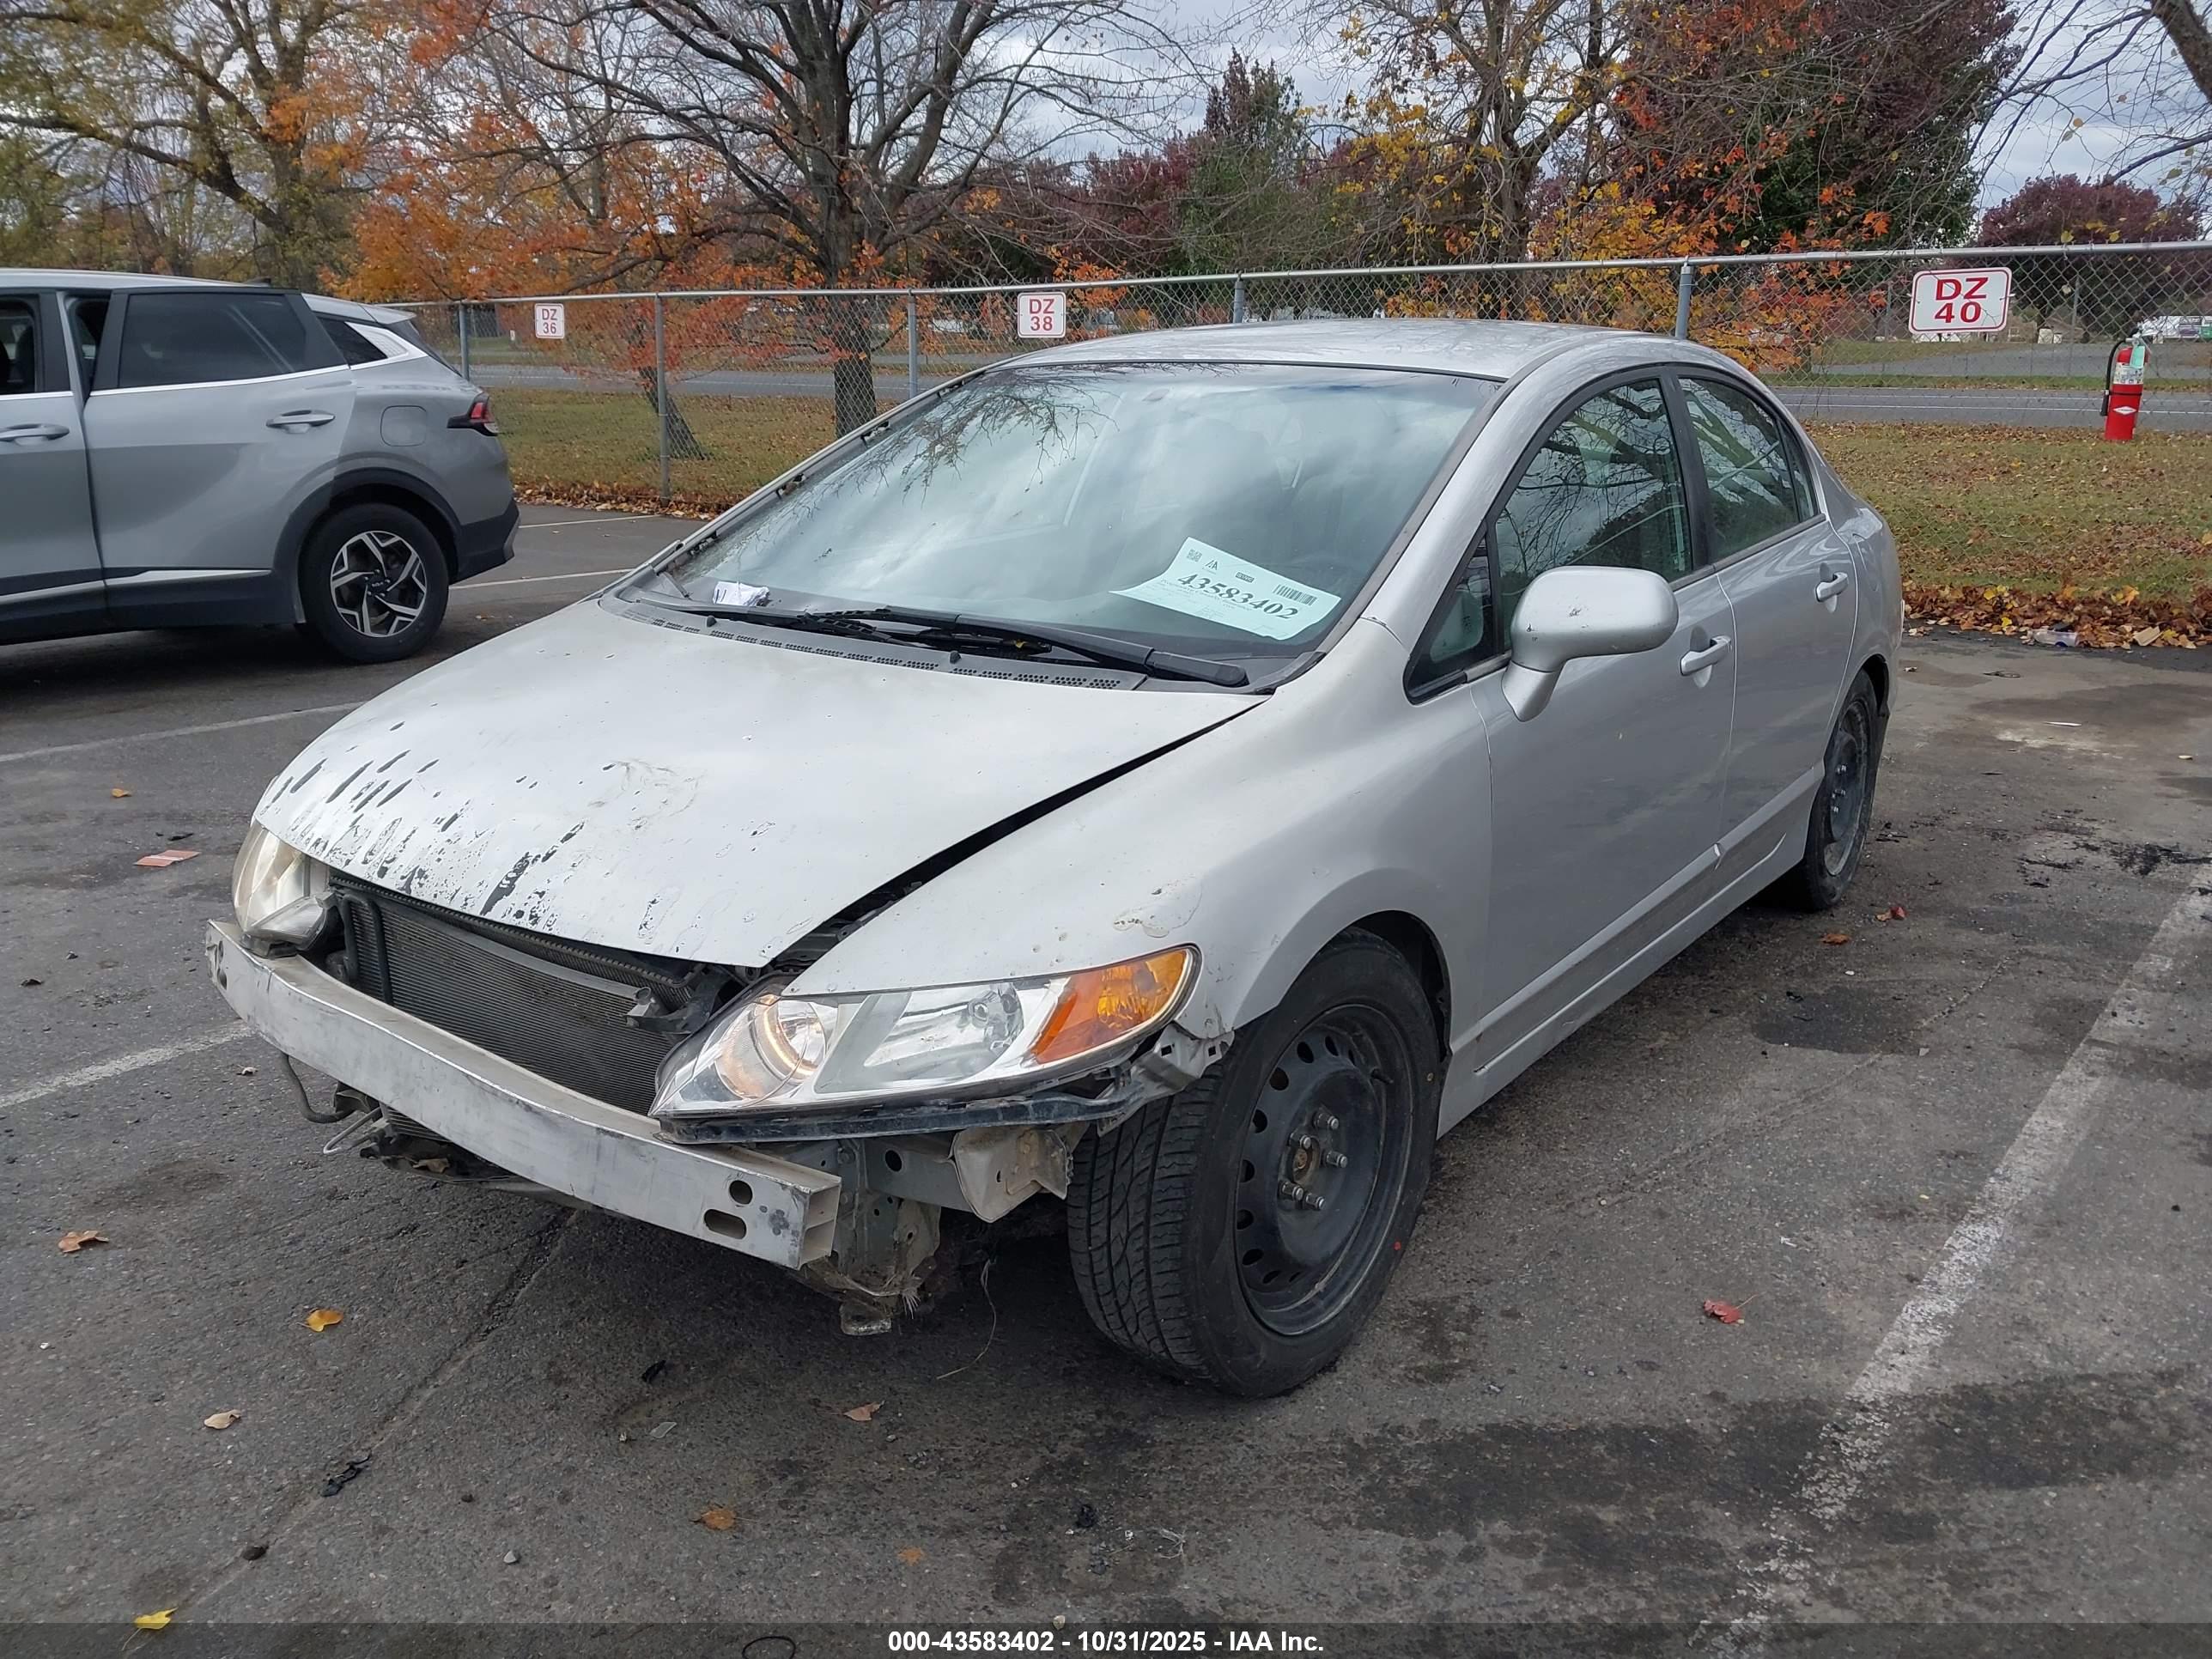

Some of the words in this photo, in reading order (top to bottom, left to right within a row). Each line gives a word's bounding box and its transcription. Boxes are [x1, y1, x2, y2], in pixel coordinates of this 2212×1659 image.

[1936, 277, 1989, 301] DZ
[542, 308, 558, 320] DZ
[1030, 298, 1054, 314] DZ
[1935, 301, 1982, 324] 40
[543, 322, 556, 334] 36
[1030, 316, 1053, 331] 38
[1177, 574, 1298, 619] 43583402
